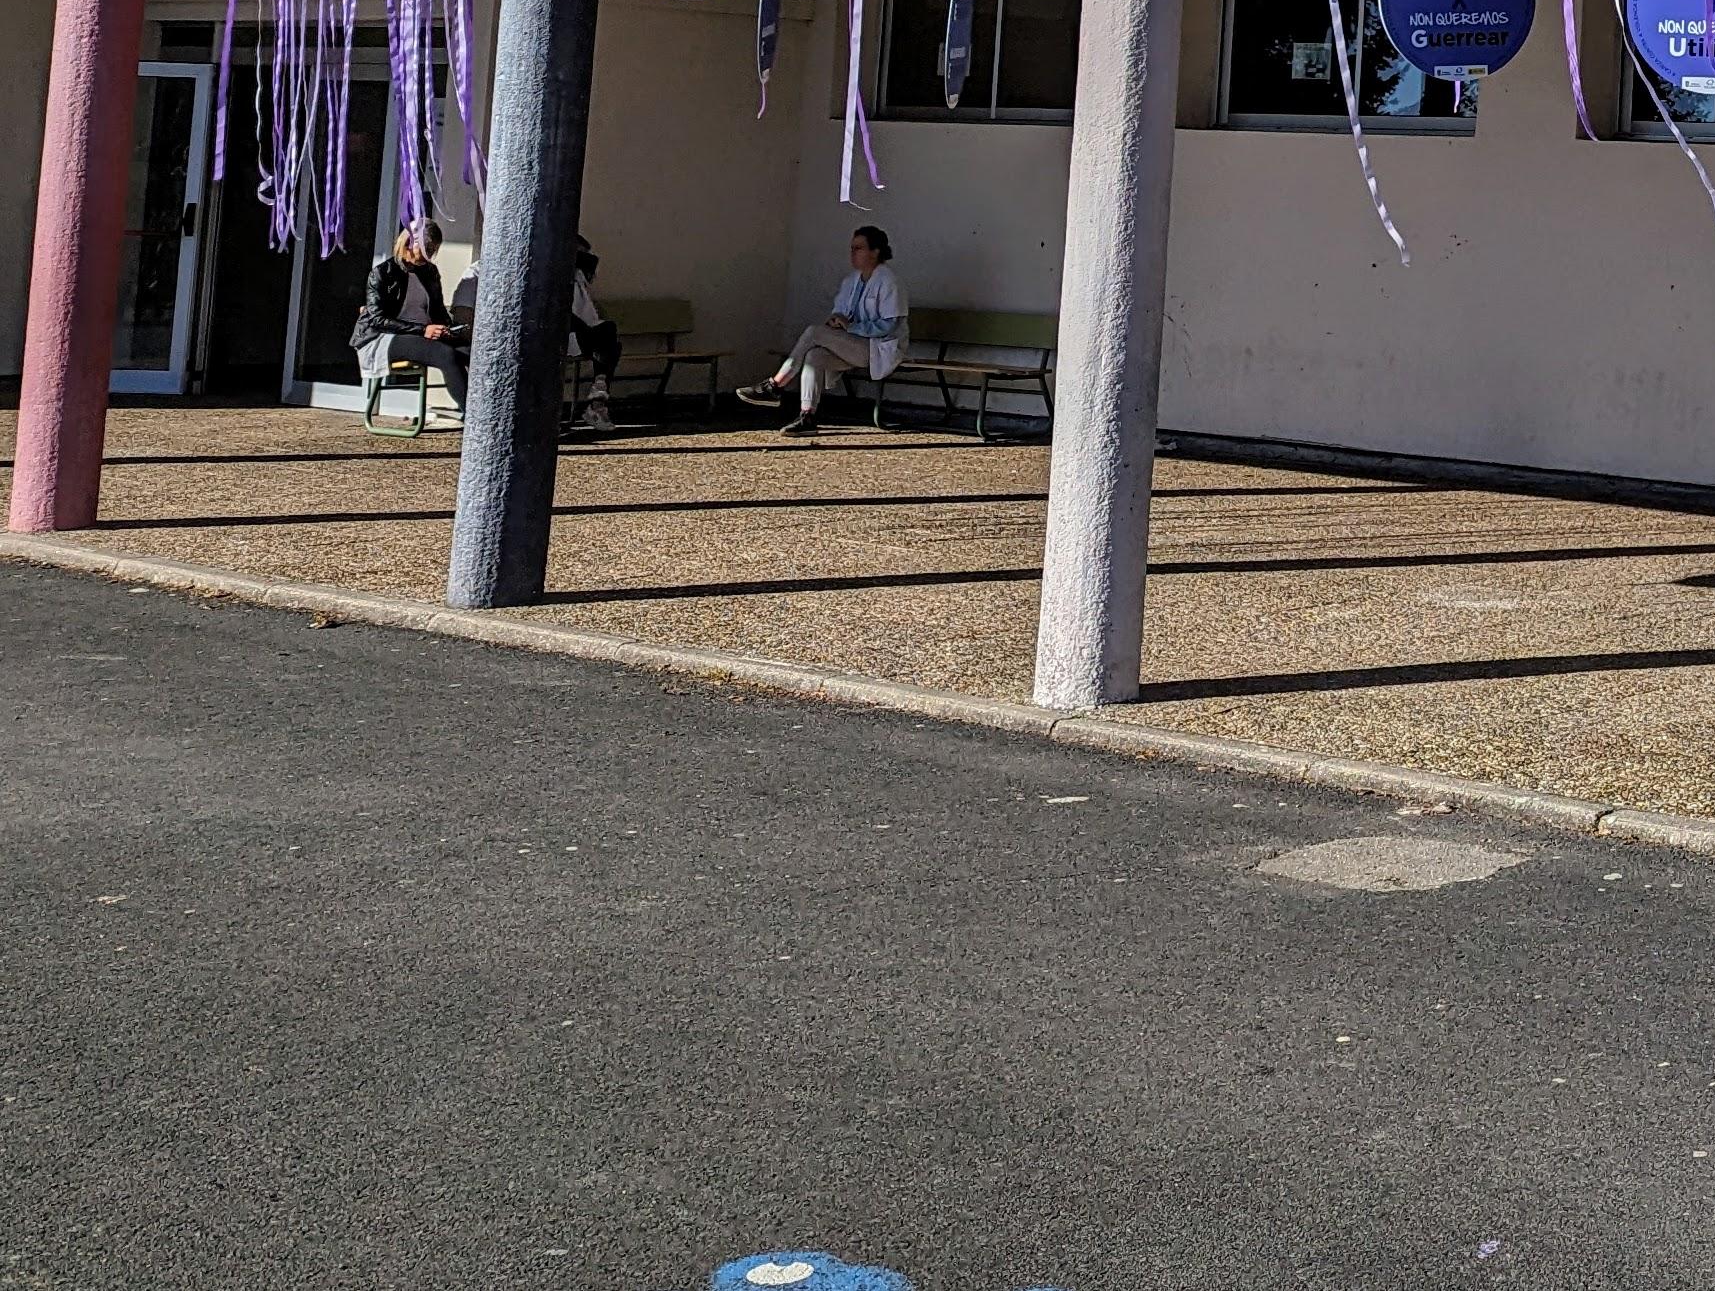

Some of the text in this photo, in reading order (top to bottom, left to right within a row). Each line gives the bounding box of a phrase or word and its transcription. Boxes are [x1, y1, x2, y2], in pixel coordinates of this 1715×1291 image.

[1410, 11, 1510, 26] NON QUEREMOS
[1658, 20, 1684, 34] NON
[1411, 29, 1510, 48] Guerrear
